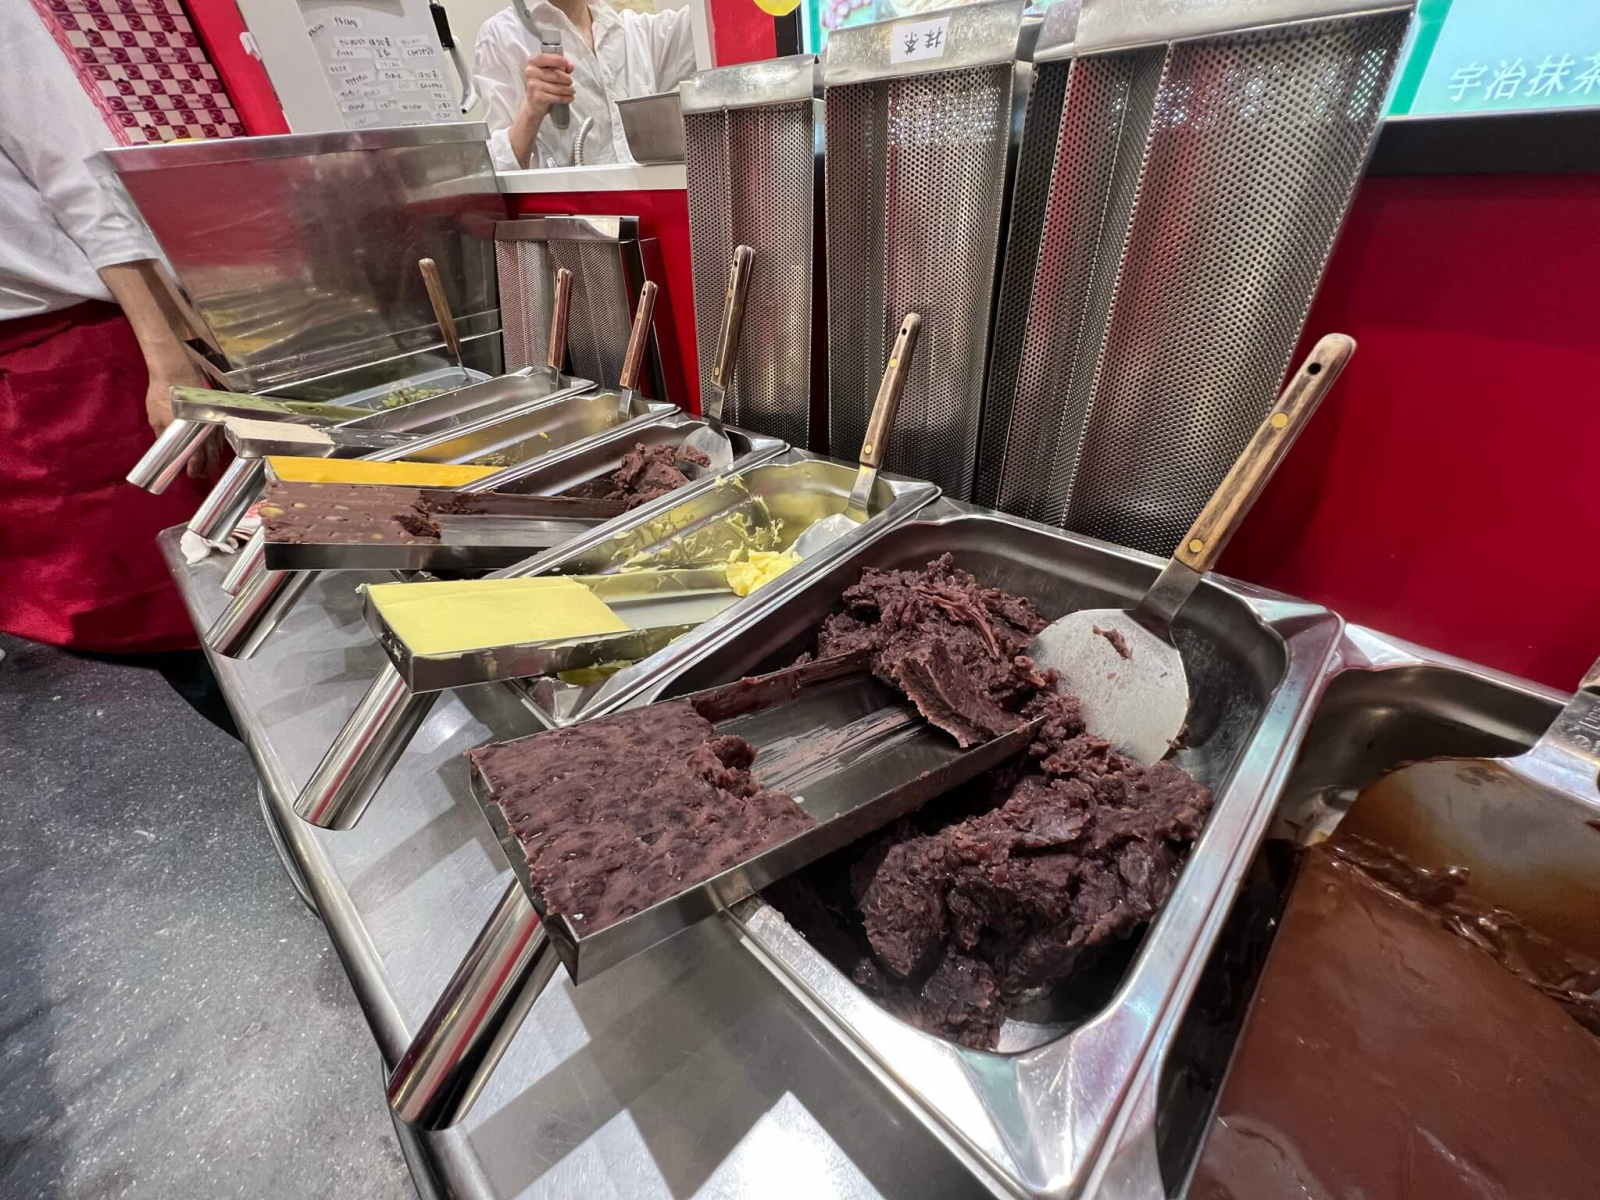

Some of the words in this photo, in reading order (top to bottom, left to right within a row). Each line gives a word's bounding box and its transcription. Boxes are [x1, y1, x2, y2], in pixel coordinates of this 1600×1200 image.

[903, 25, 943, 55] 抹茶
[1447, 51, 1600, 102] 宇治抹茶
